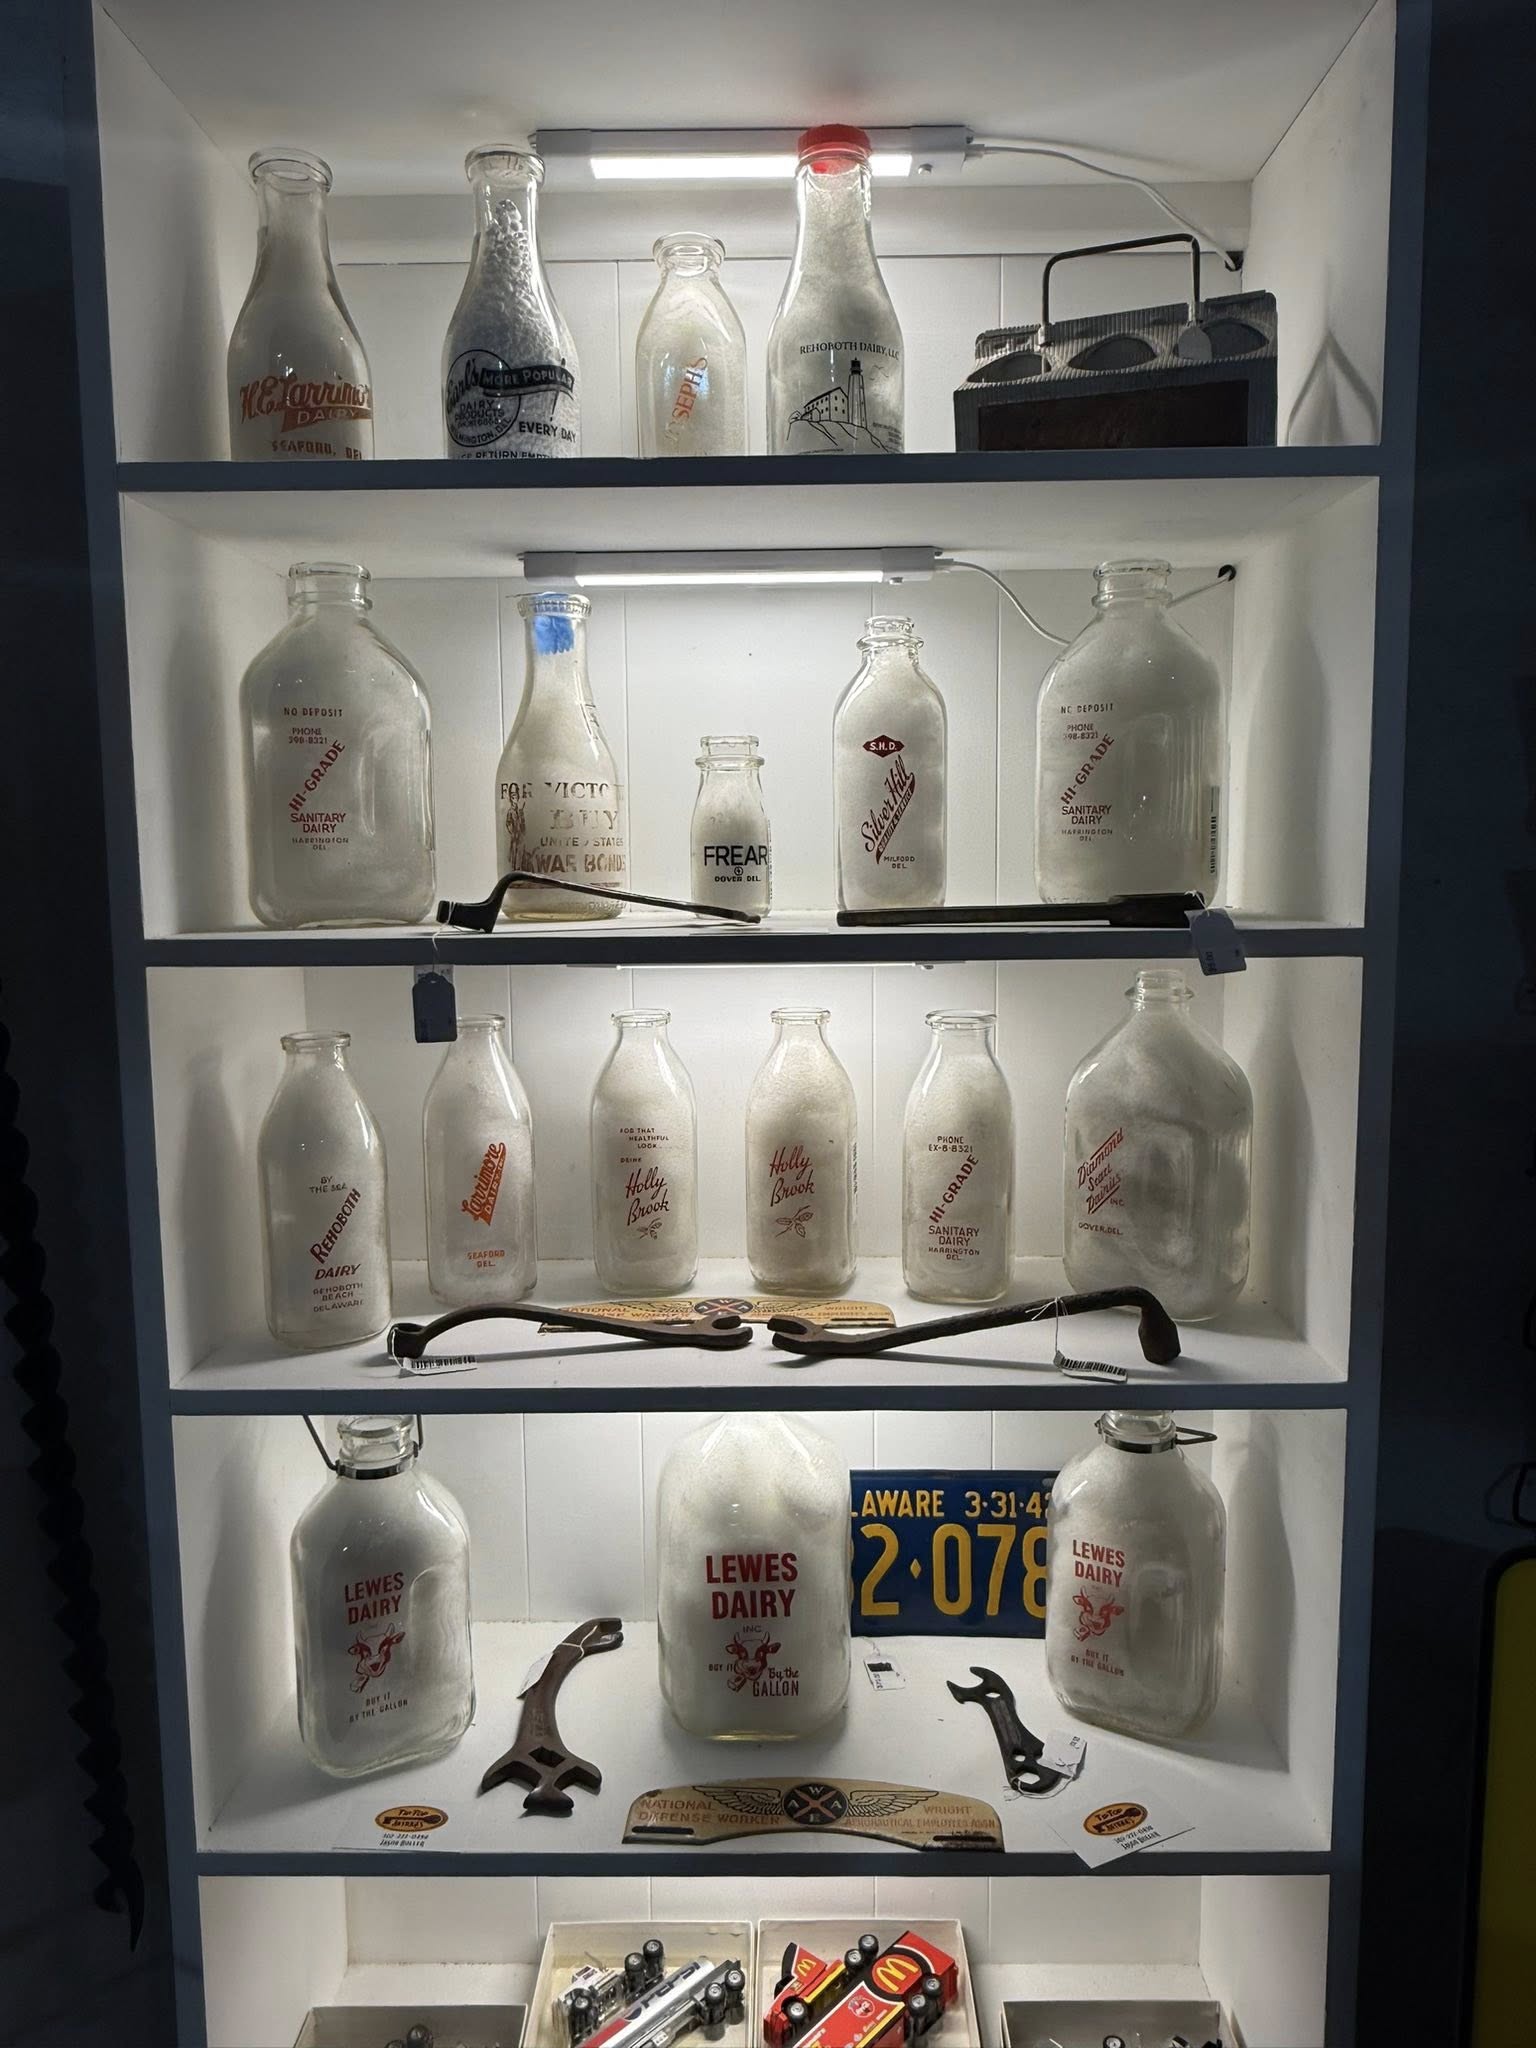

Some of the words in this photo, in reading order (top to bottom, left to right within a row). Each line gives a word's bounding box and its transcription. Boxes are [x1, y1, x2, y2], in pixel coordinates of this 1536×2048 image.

[800, 341, 858, 355] REHOBOTH
[460, 399, 495, 413] DAIRY
[297, 409, 358, 425] DAIRY
[518, 421, 558, 437] EVERY
[560, 427, 577, 444] DAY
[283, 707, 298, 716] NO
[302, 707, 343, 717] DEPOSIT
[1077, 703, 1114, 713] DEPOSIT
[292, 727, 322, 736] PHONE
[1067, 723, 1094, 732] PHONE
[289, 739, 346, 812] HI-GRADE
[1060, 733, 1115, 805] HI-GRADE
[861, 797, 895, 853] Silver
[884, 753, 910, 805] Hill
[1061, 804, 1112, 816] SANITARY
[290, 812, 346, 824] SANITARY
[1071, 815, 1102, 825] DAIRY
[303, 823, 337, 834] DAIRY
[937, 1135, 964, 1144] PHONE
[769, 1145, 812, 1181] Holly
[320, 1175, 333, 1185] BY
[625, 1165, 668, 1201] Holly
[309, 1185, 329, 1194] THE
[330, 1183, 348, 1193] SEA
[482, 1173, 501, 1215] DAIRY
[770, 1169, 815, 1208] Brook
[929, 1153, 979, 1224] HI-GRADE
[627, 1188, 670, 1227] Brook
[309, 1188, 361, 1265] REHOBOTH
[928, 1225, 980, 1238] SANITARY
[938, 1235, 971, 1247] DAIRY
[467, 1250, 505, 1260] SEAFORD
[315, 1263, 361, 1280] DAIRY
[313, 1282, 363, 1295] REHOBOTH
[322, 1291, 354, 1301] BEACH
[851, 1490, 945, 1518] AWARE
[1072, 1539, 1126, 1569] LEWES
[706, 1552, 798, 1584] LEWES
[1074, 1560, 1123, 1588] DAIRY
[344, 1572, 404, 1603] LEWES
[348, 1595, 402, 1626] DAIRY
[711, 1589, 796, 1620] DAIRY
[1082, 1658, 1095, 1669] THE
[1102, 1651, 1109, 1663] IT
[708, 1663, 723, 1672] BUY
[768, 1667, 783, 1683] By
[785, 1667, 799, 1679] the
[752, 1680, 799, 1697] GALLON
[366, 1695, 381, 1706] BUY
[362, 1707, 375, 1719] THE
[379, 1698, 408, 1713] GALLON
[640, 1799, 716, 1811] NATIONAL
[923, 1804, 973, 1815] WRIGHT
[639, 1811, 710, 1823] DEFENSE
[719, 1814, 780, 1825] WORKER
